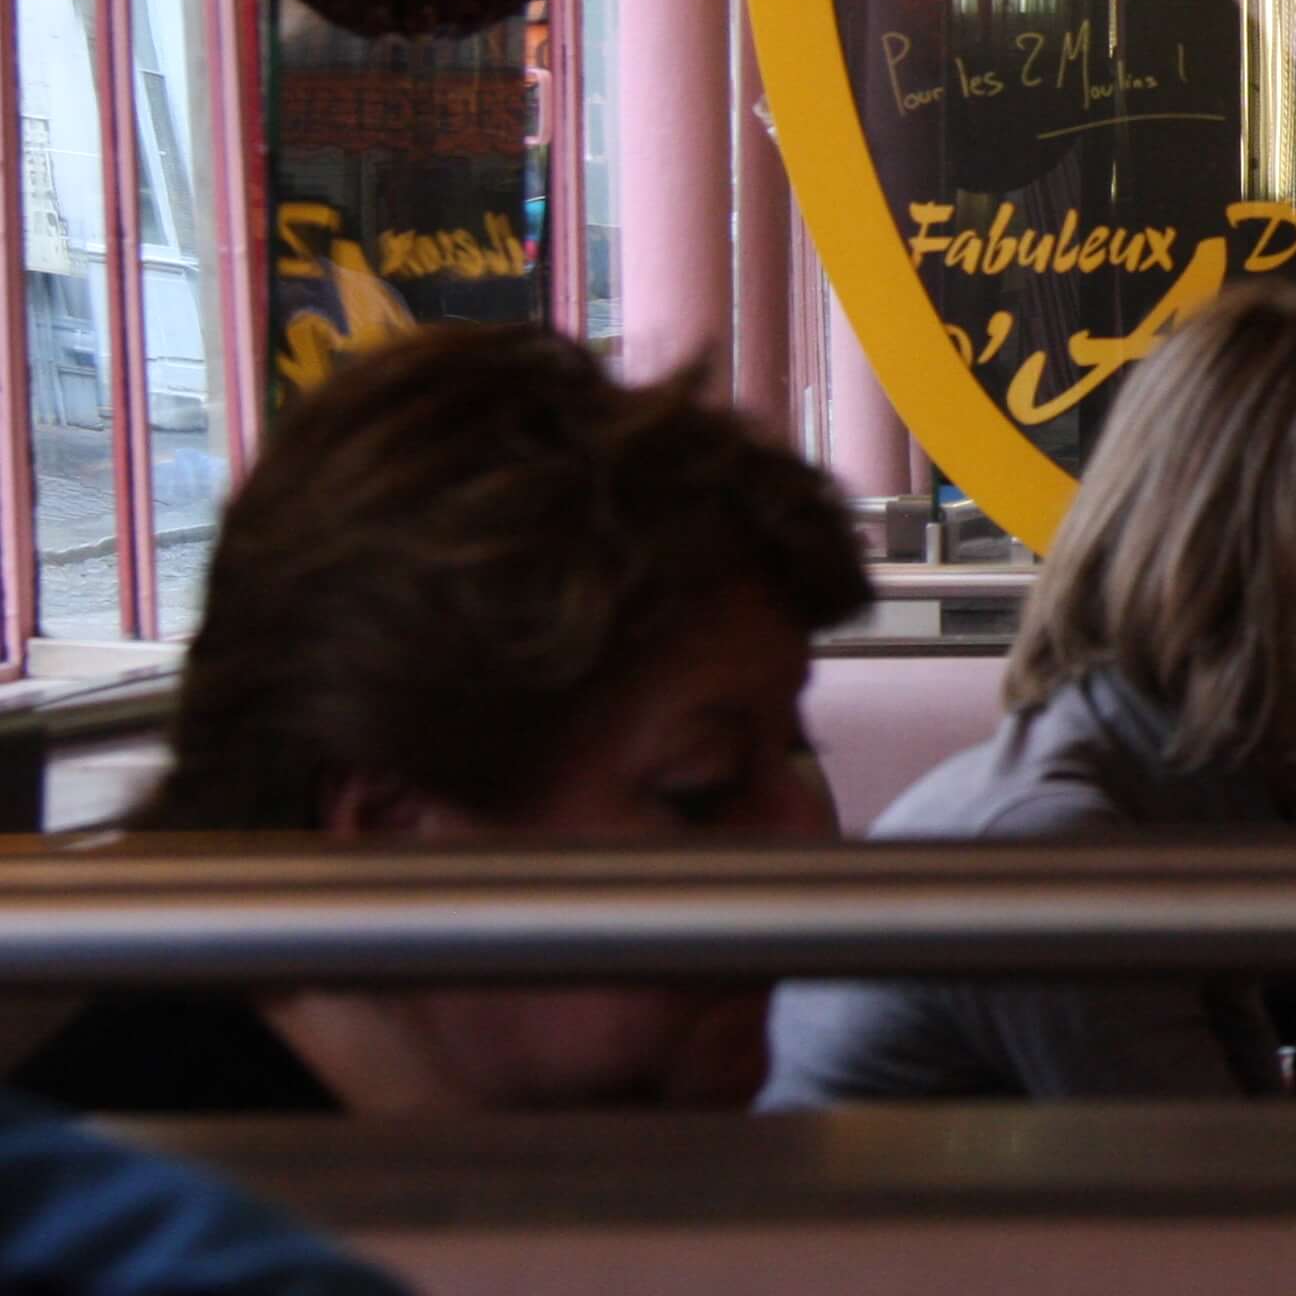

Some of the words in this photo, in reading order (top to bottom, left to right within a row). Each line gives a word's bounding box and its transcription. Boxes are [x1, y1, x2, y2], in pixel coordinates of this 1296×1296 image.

[881, 31, 945, 117] Pour
[955, 56, 1005, 98] les
[1015, 32, 1046, 88] 2
[1055, 17, 1160, 112] Moulins
[908, 200, 1180, 277] Fabuleux
